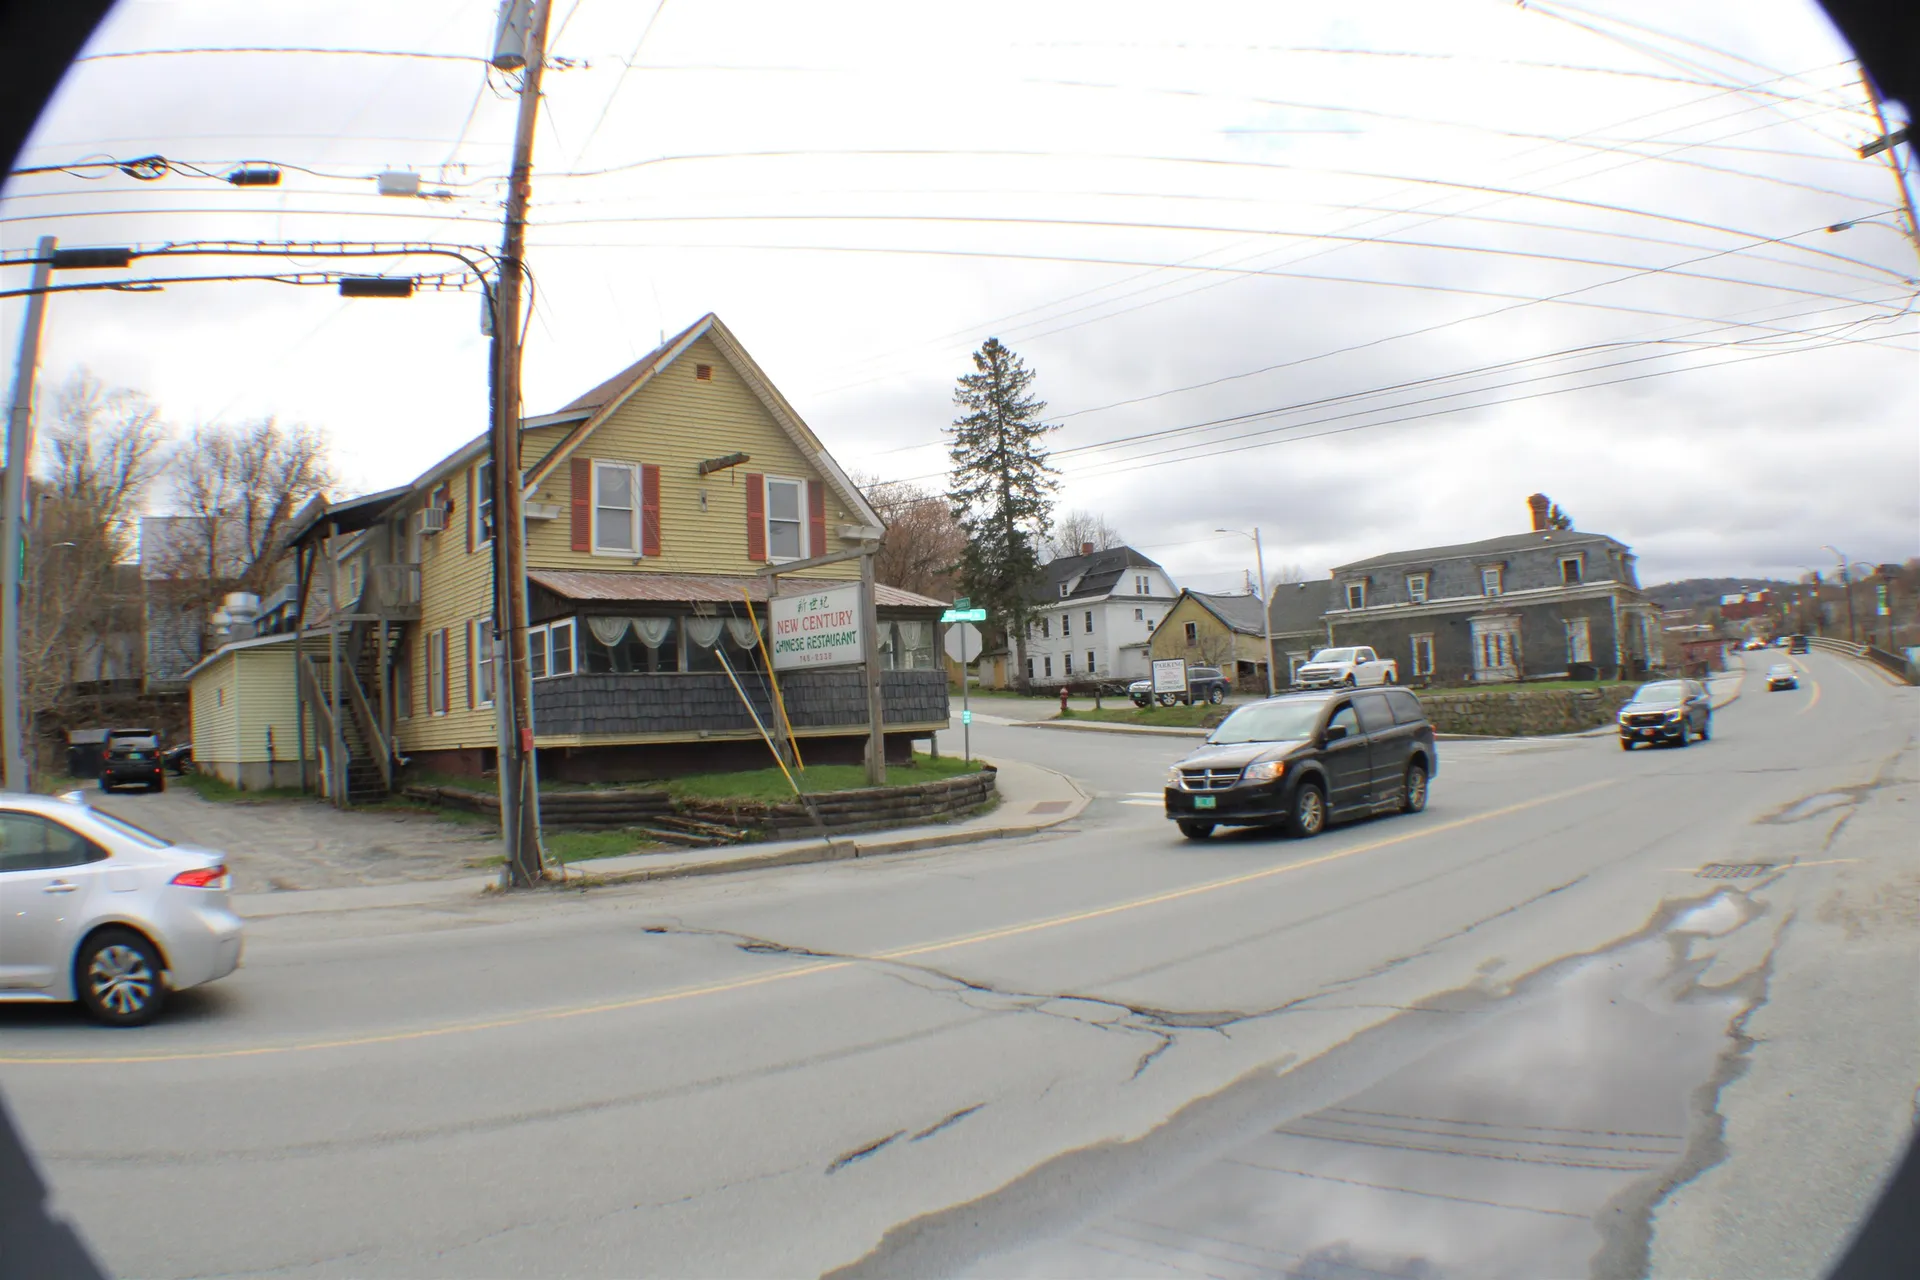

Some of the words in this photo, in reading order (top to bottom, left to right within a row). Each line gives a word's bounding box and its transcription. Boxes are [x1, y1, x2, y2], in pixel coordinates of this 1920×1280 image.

[777, 618, 799, 635] NEW
[802, 610, 853, 631] CENTURY
[776, 636, 805, 654] CHINESE
[806, 630, 857, 650] RESTAURANT
